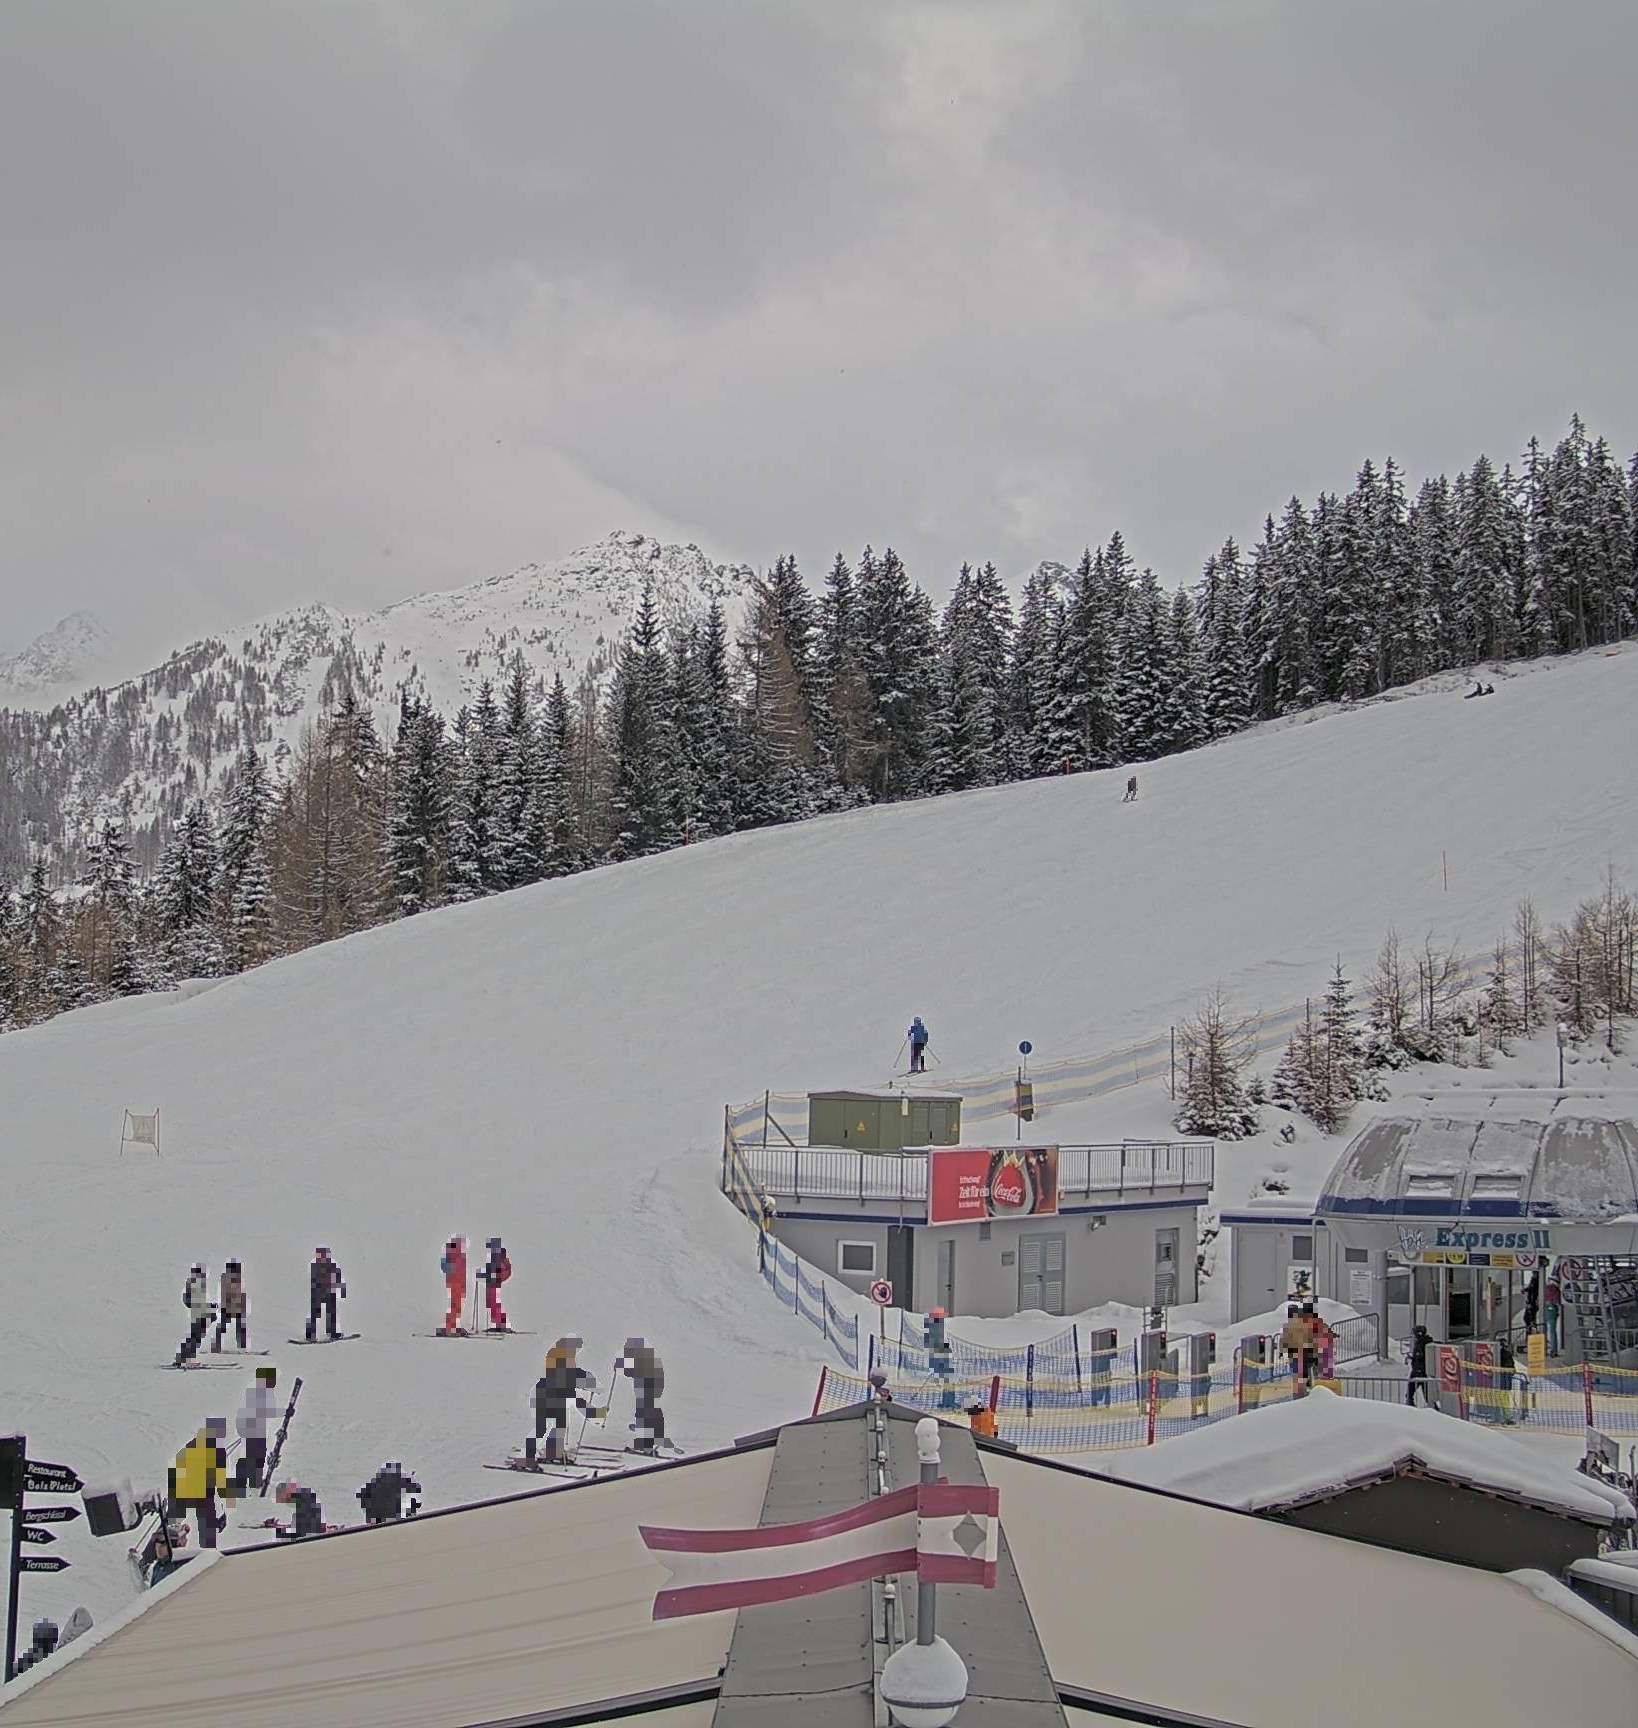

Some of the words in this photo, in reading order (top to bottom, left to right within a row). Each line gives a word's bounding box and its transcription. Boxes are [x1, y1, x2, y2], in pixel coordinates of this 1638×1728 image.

[1436, 1227, 1529, 1251] Express
[1533, 1229, 1550, 1249] II
[27, 1463, 67, 1478] Restaurant
[27, 1529, 45, 1541] WC
[26, 1559, 60, 1570] Terrasse
